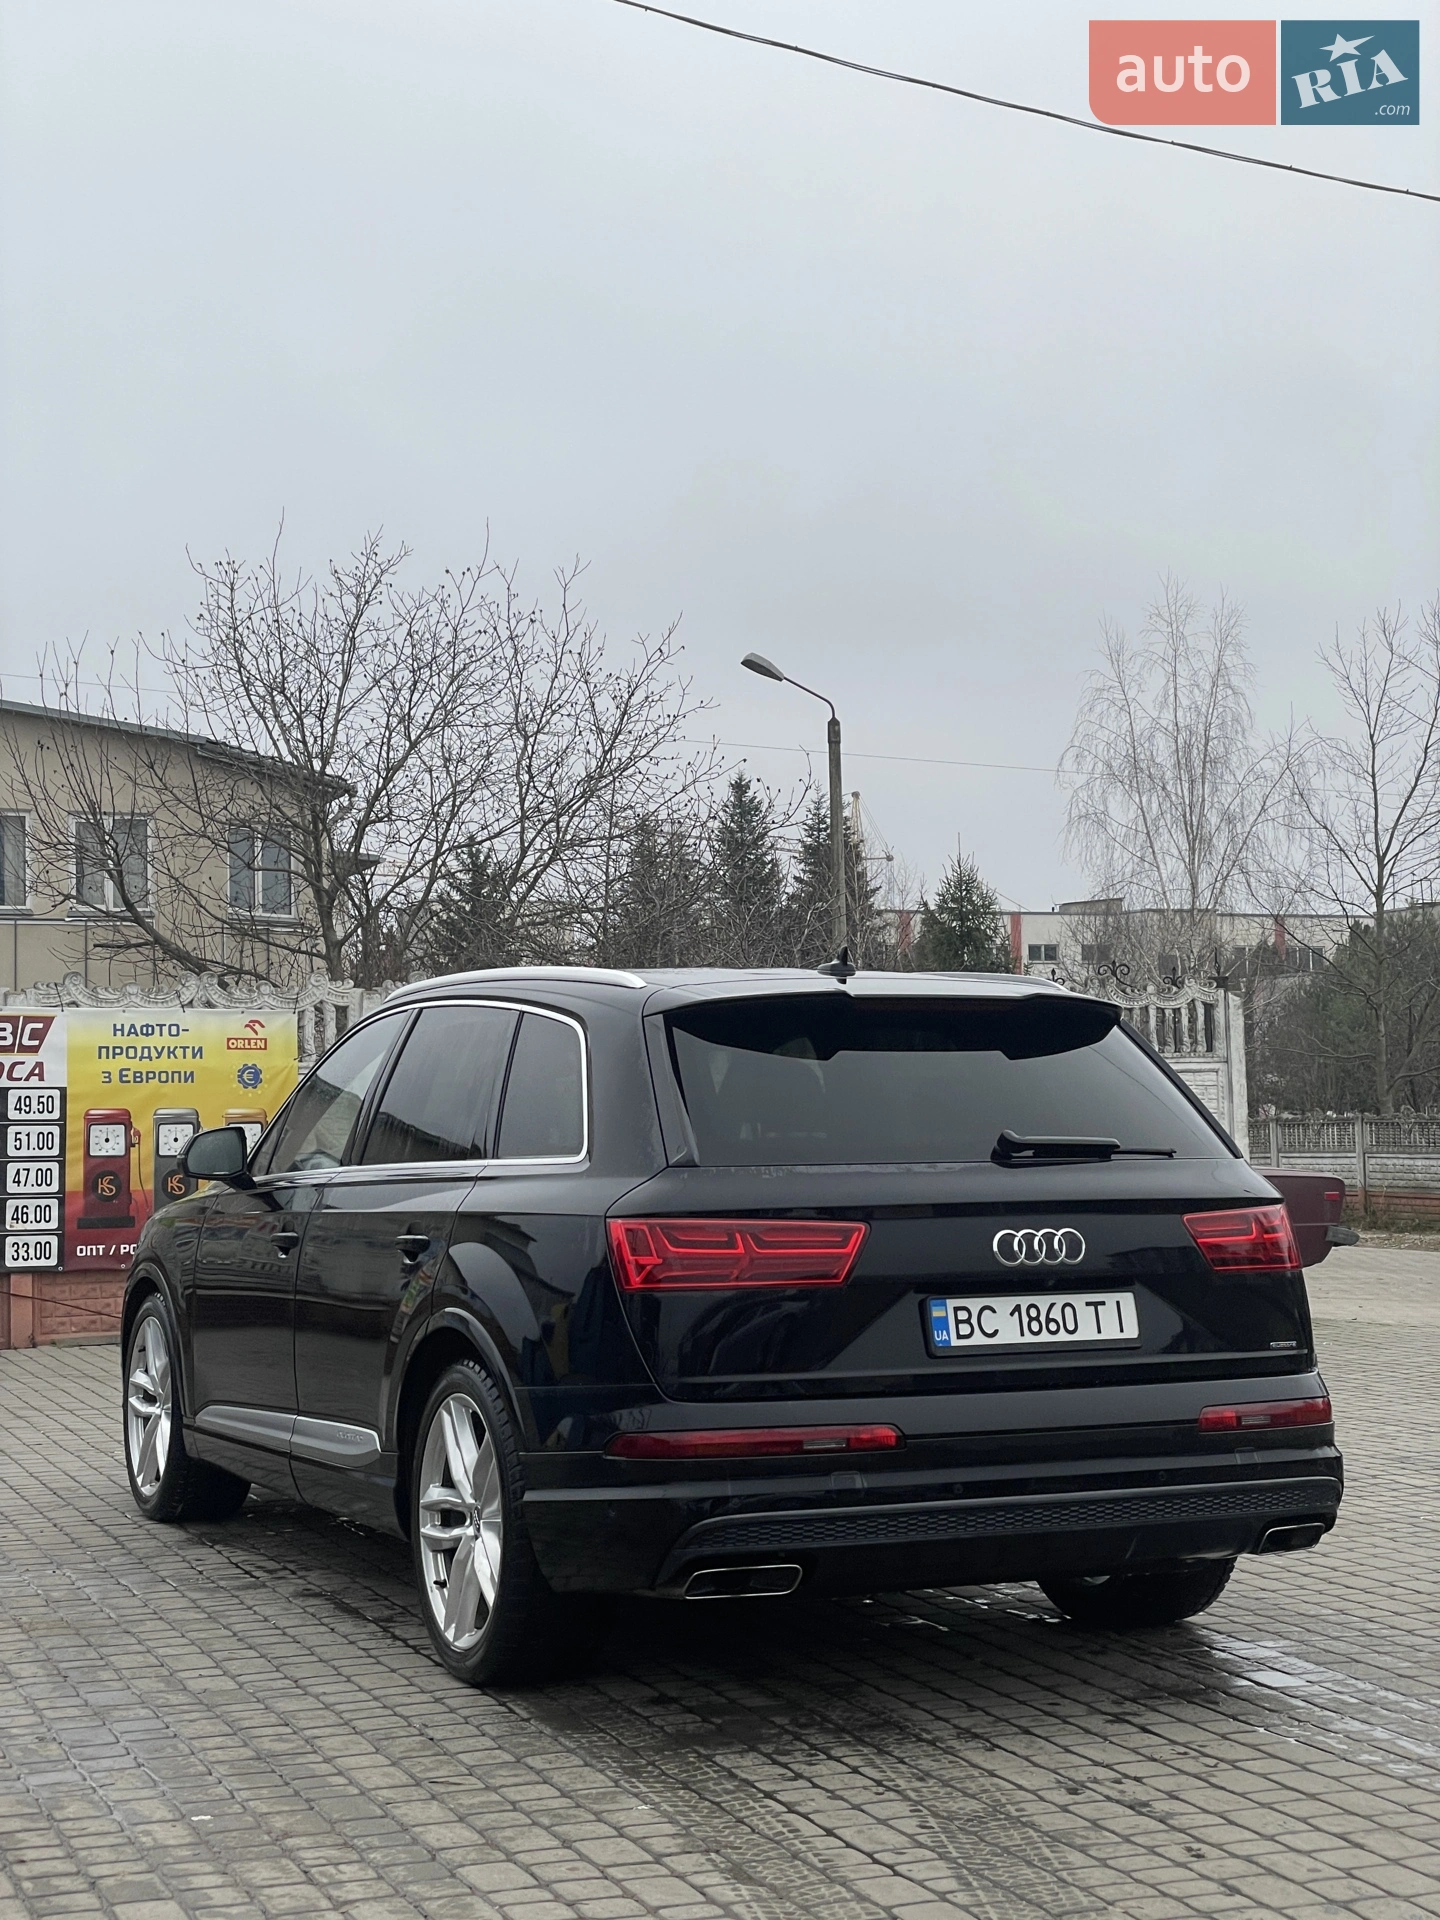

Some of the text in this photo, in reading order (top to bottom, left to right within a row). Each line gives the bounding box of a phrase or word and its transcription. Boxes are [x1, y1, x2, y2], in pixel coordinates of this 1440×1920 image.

[112, 1023, 190, 1037] НАФТО-
[98, 1046, 203, 1061] ПРОДУКТИ
[229, 1039, 265, 1049] ORLEN
[14, 1095, 54, 1114] 49.50
[14, 1132, 54, 1151] 51.00
[12, 1168, 53, 1187] 47.00
[11, 1204, 52, 1224] 46.00
[11, 1241, 52, 1261] 33.00
[77, 1245, 105, 1256] ОПТ
[934, 1300, 1124, 1341] UA BC 1860 TI
